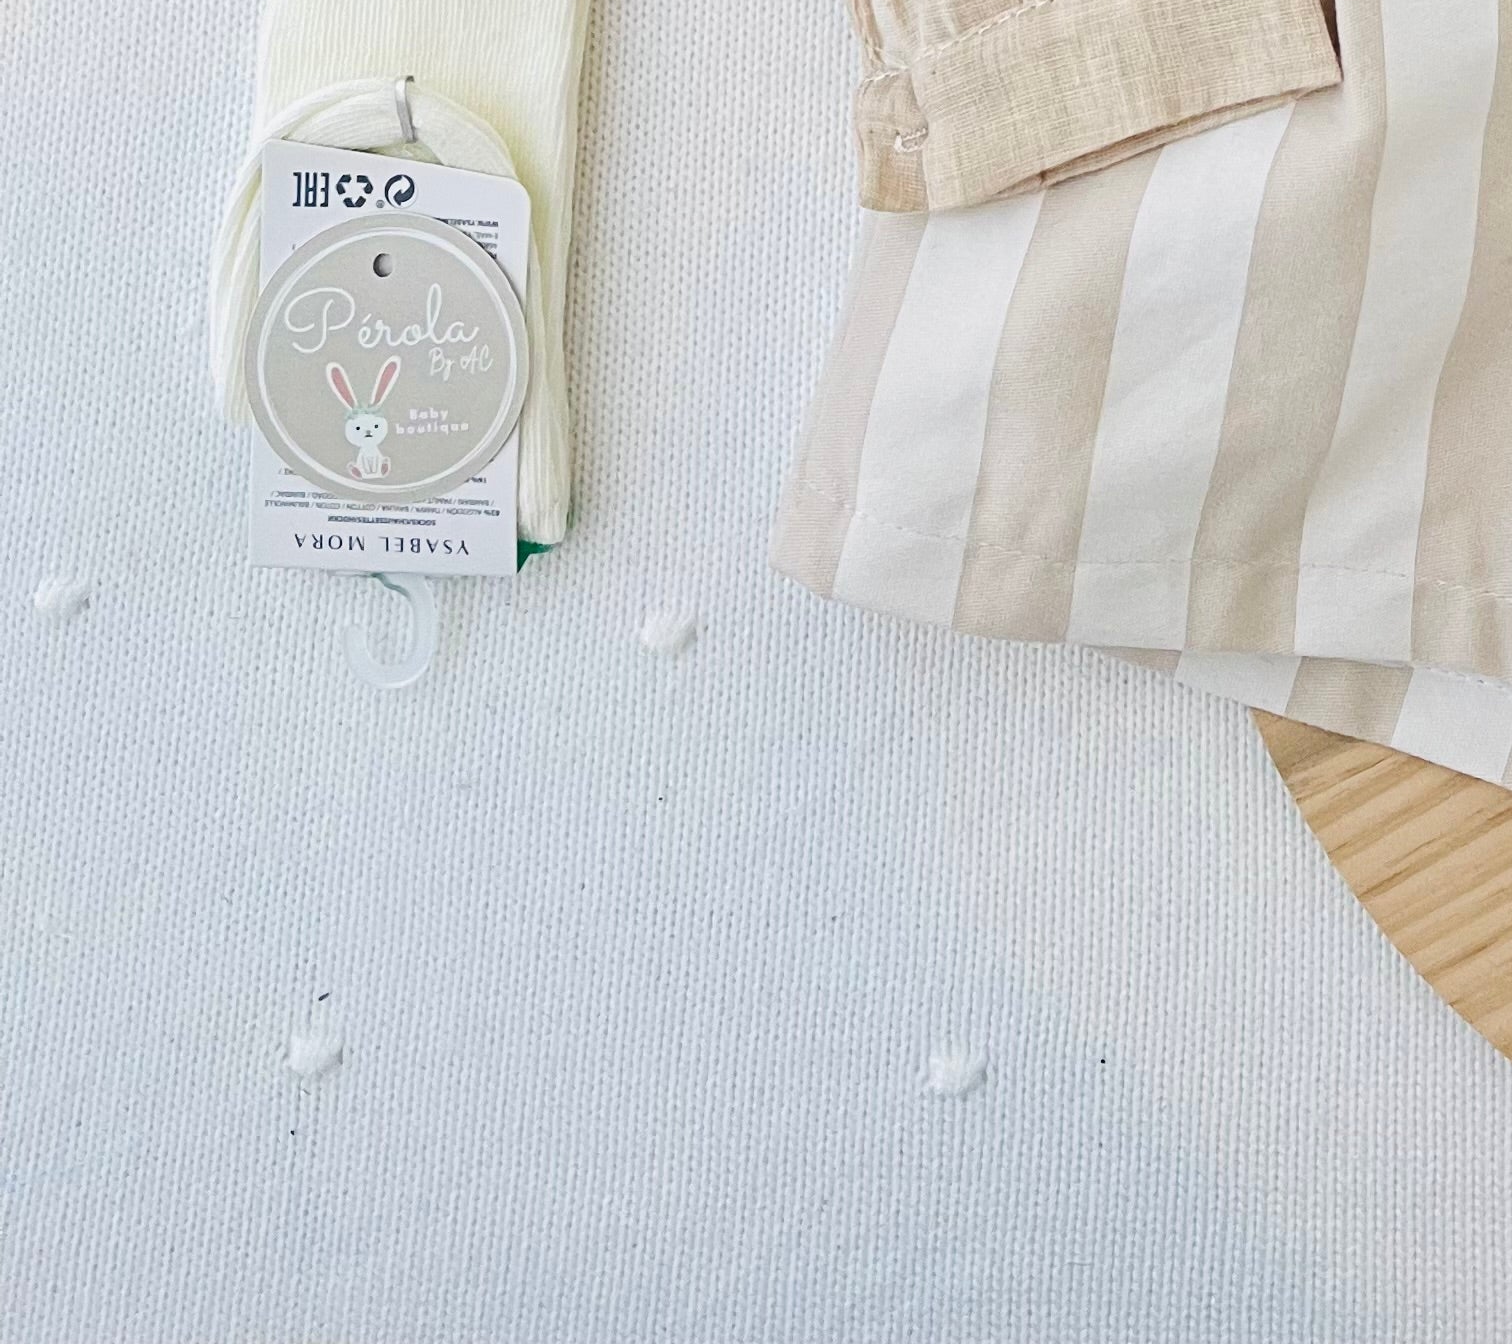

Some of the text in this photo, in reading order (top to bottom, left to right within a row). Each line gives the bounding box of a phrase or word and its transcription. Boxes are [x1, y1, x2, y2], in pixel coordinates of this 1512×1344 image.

[284, 283, 480, 354] Pérola
[429, 346, 455, 378] By
[408, 407, 450, 421] Baby
[395, 419, 470, 435] boutique
[293, 533, 470, 556] YSABEL MORA
